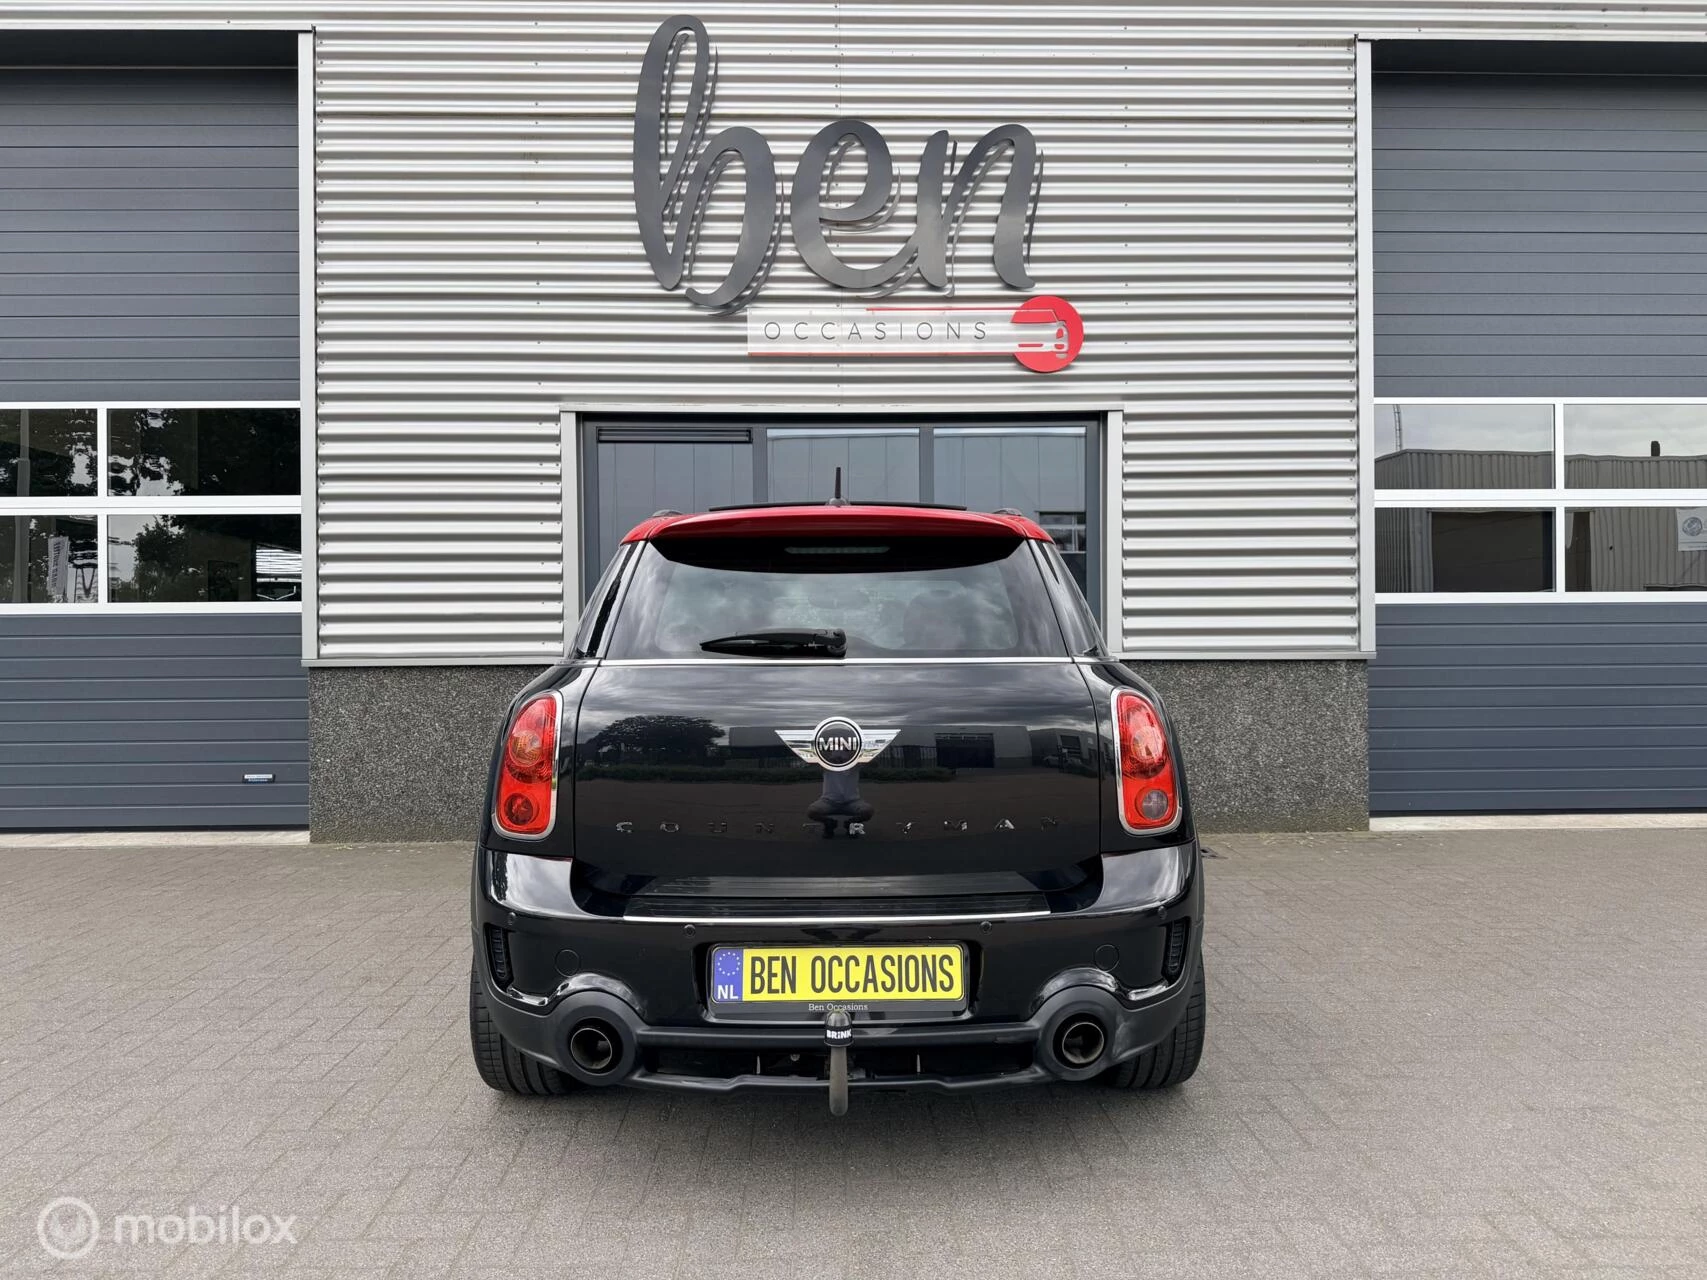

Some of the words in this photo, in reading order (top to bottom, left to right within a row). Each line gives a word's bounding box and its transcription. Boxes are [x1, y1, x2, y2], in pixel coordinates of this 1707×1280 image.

[633, 14, 1037, 307] ben
[764, 321, 987, 341] OCCASIONS
[818, 736, 857, 751] MINI
[750, 955, 797, 995] BEN
[811, 954, 954, 994] OCCASIONS
[717, 985, 739, 999] NL
[808, 1003, 825, 1011] Ben
[826, 1002, 869, 1011] Occasions
